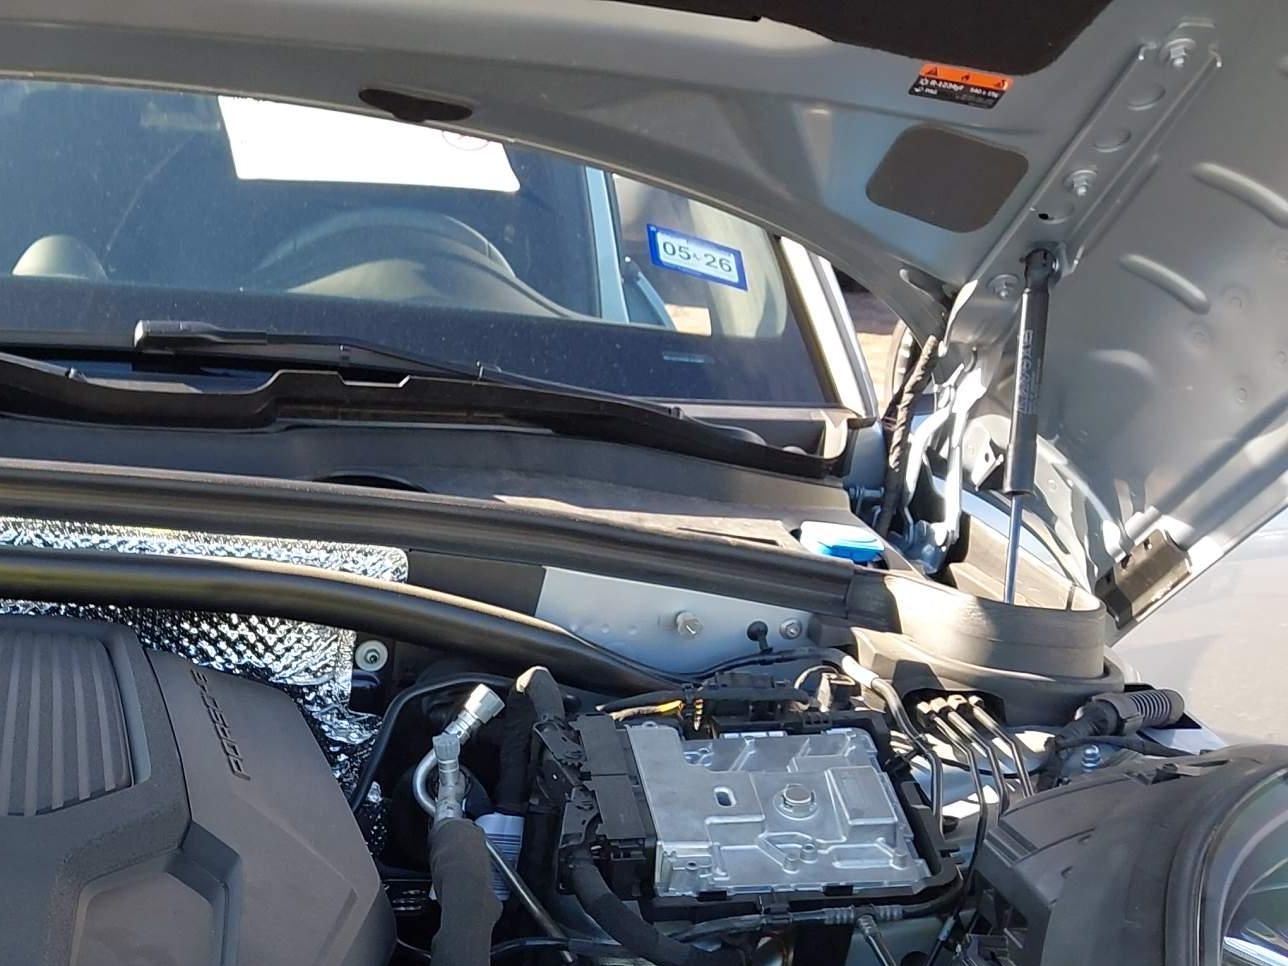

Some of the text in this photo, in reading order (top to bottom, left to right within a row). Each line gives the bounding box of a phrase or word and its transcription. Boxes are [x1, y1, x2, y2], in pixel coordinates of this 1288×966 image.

[662, 241, 732, 273] 05 26
[191, 669, 251, 780] PORSCHE
